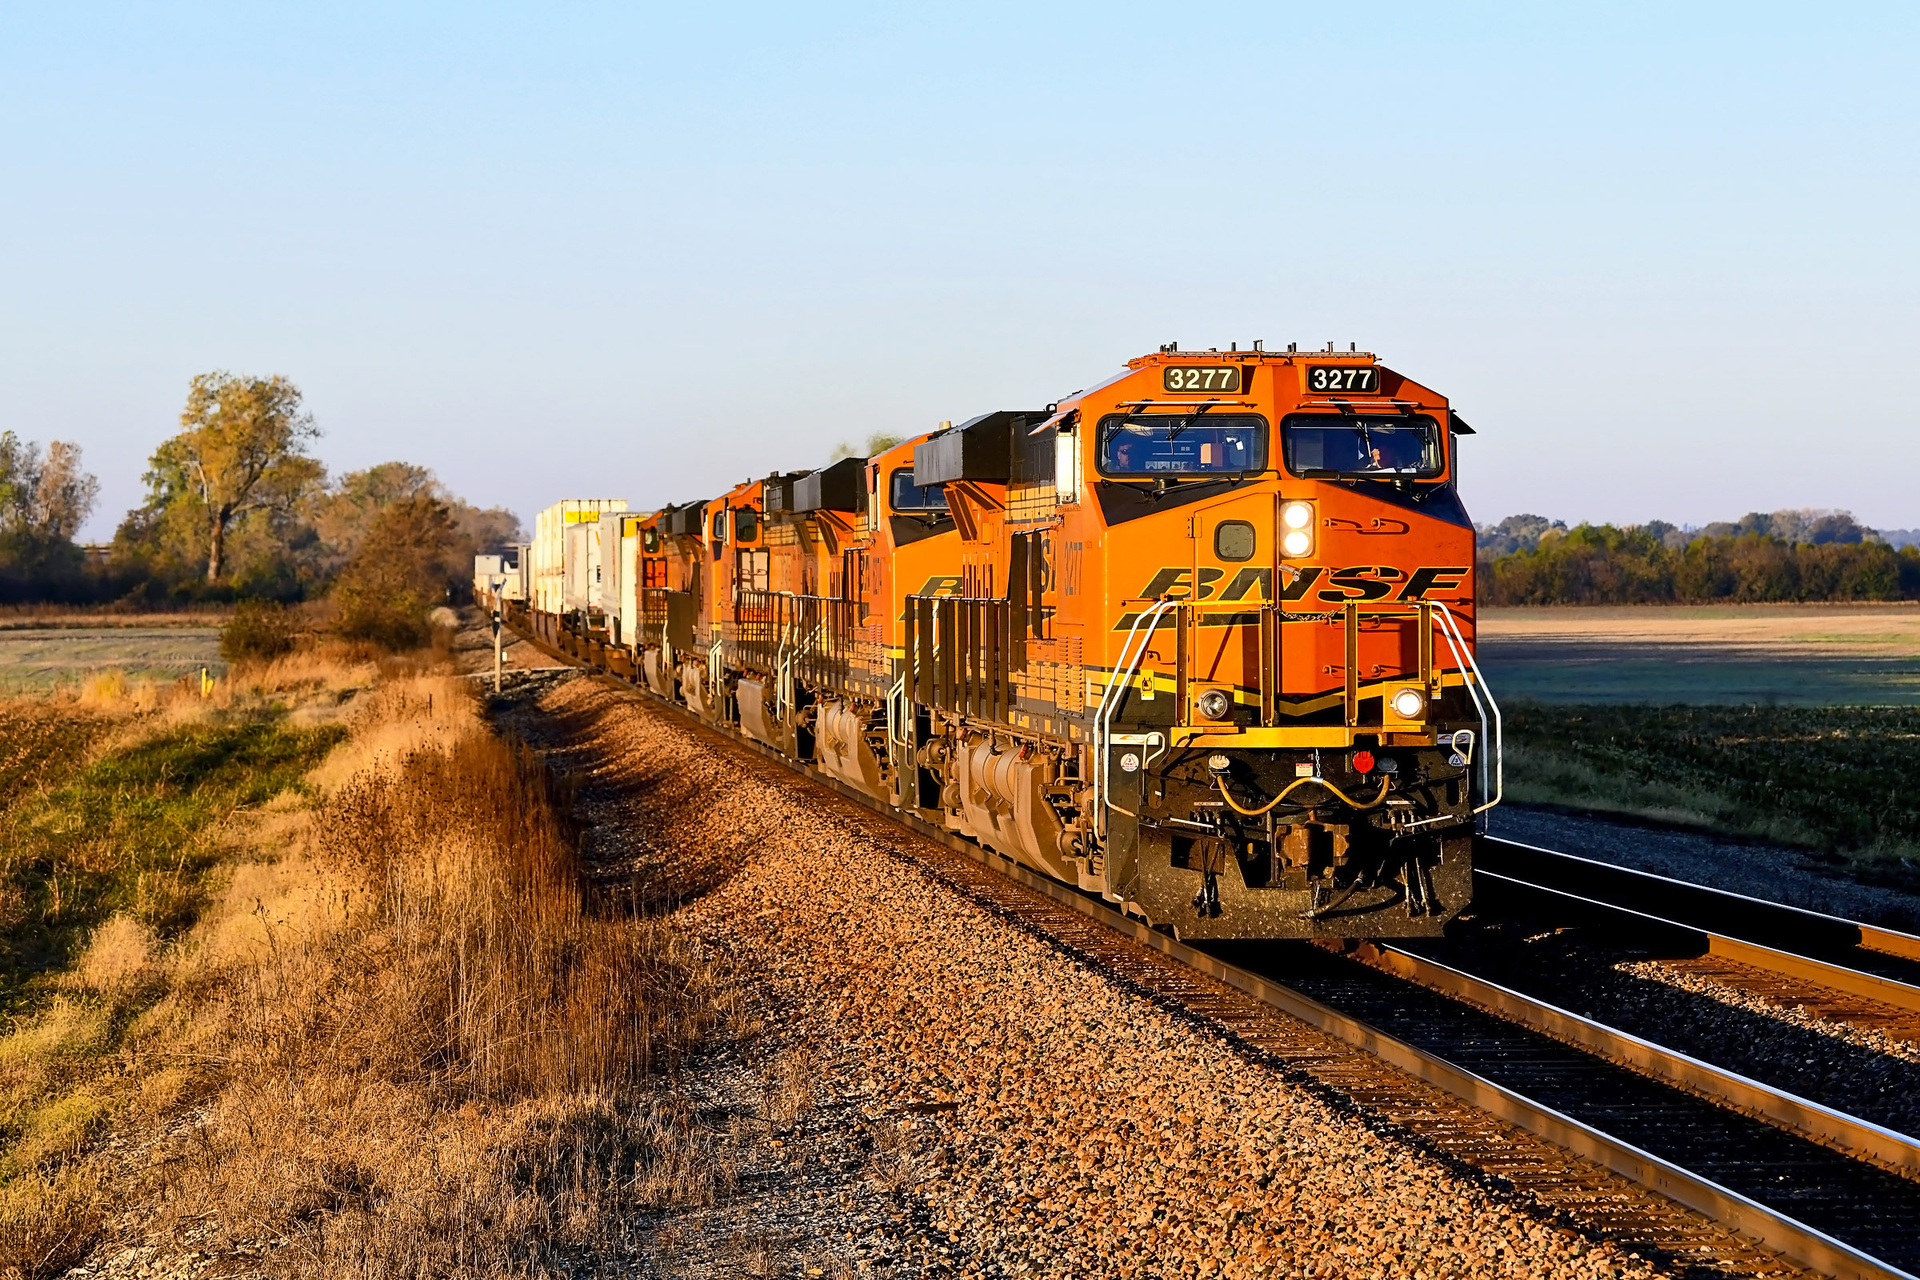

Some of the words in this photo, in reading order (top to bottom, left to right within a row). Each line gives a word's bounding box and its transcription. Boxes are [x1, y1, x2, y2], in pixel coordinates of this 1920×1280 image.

[1169, 368, 1233, 389] 3277
[1313, 368, 1372, 390] 3277
[1065, 541, 1083, 596] 3277
[1137, 566, 1472, 602] BNSF
